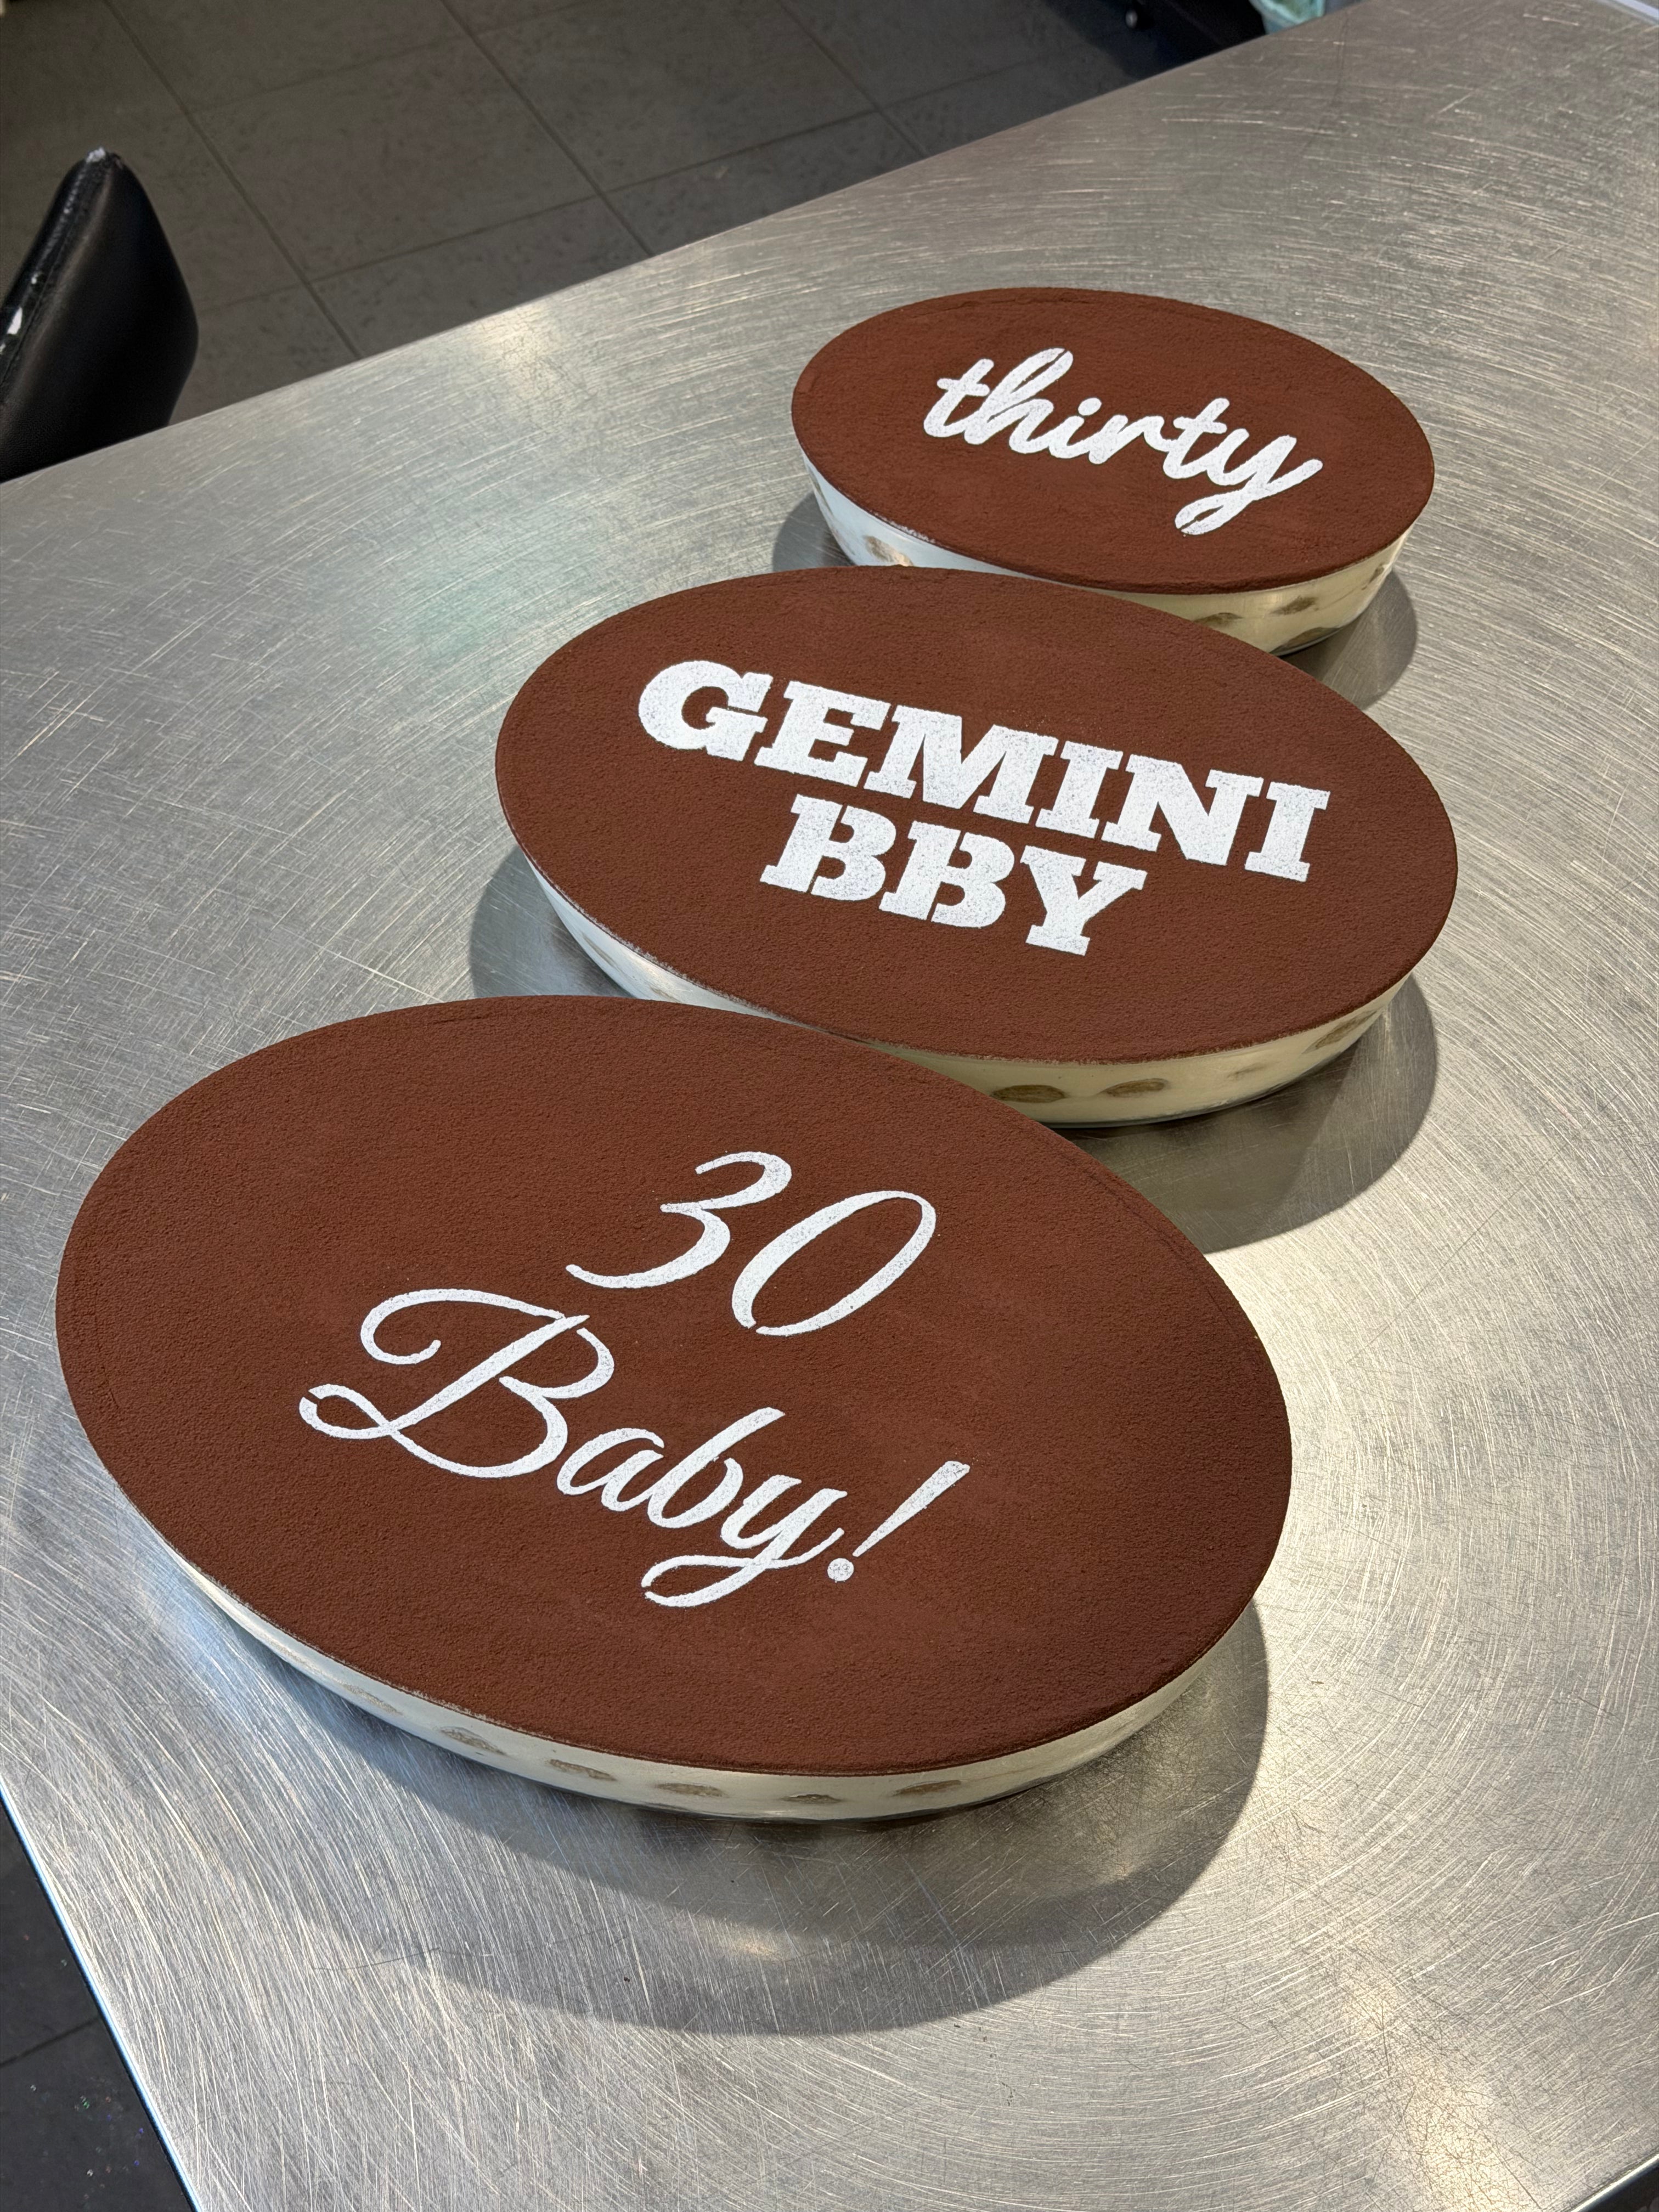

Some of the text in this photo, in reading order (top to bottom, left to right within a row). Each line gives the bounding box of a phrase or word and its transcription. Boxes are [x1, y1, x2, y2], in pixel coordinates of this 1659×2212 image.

[923, 347, 1323, 535] thirty
[638, 660, 1331, 882] GEMINI
[759, 793, 1148, 956] BBY
[565, 1151, 936, 1337] 30
[298, 1288, 970, 1607] Baby!
